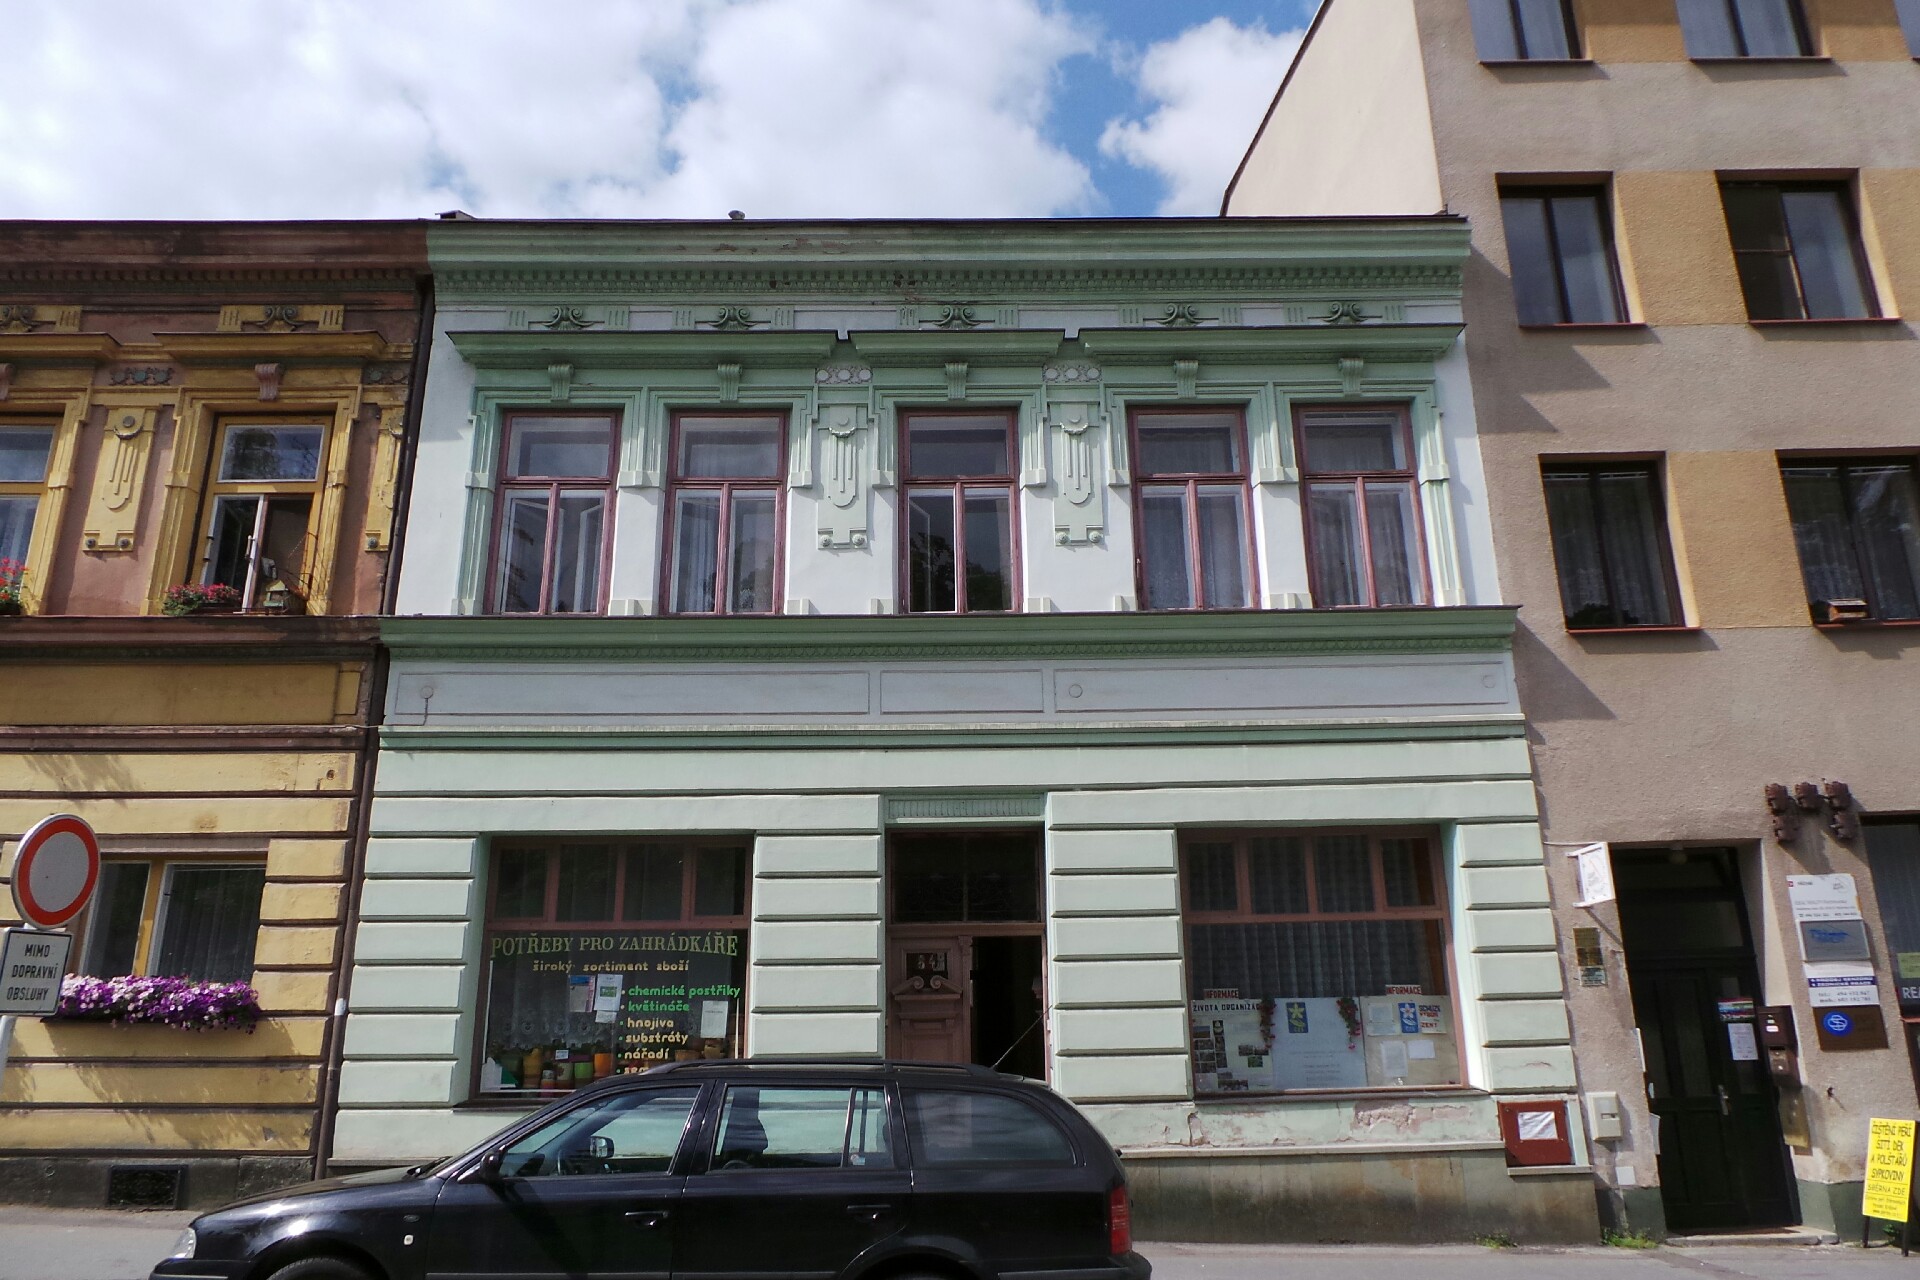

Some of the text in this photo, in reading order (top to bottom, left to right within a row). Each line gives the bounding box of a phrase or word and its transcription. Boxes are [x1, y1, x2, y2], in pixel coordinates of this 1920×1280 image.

[24, 944, 50, 957] MIMO
[490, 932, 738, 958] POTŘEBY PRO ZAHRÁDKÁŘE
[12, 963, 58, 979] DOPRAVNÍ
[533, 960, 689, 973] široký sortiment zboží
[7, 986, 49, 1000] OBSLUHY
[628, 984, 740, 999] chemické postřiky
[1204, 990, 1239, 999] INFORMACE
[1386, 986, 1422, 994] INFORMACE
[628, 1000, 689, 1012] květináče
[627, 1018, 674, 1030] hnojiva
[625, 1033, 688, 1044] substráty
[624, 1048, 670, 1059] nářadí
[1872, 1121, 1912, 1137] ČIŠTĚNÍ PEŘÍ
[1893, 1140, 1904, 1151] DEK
[1893, 1187, 1906, 1195] ZDE
